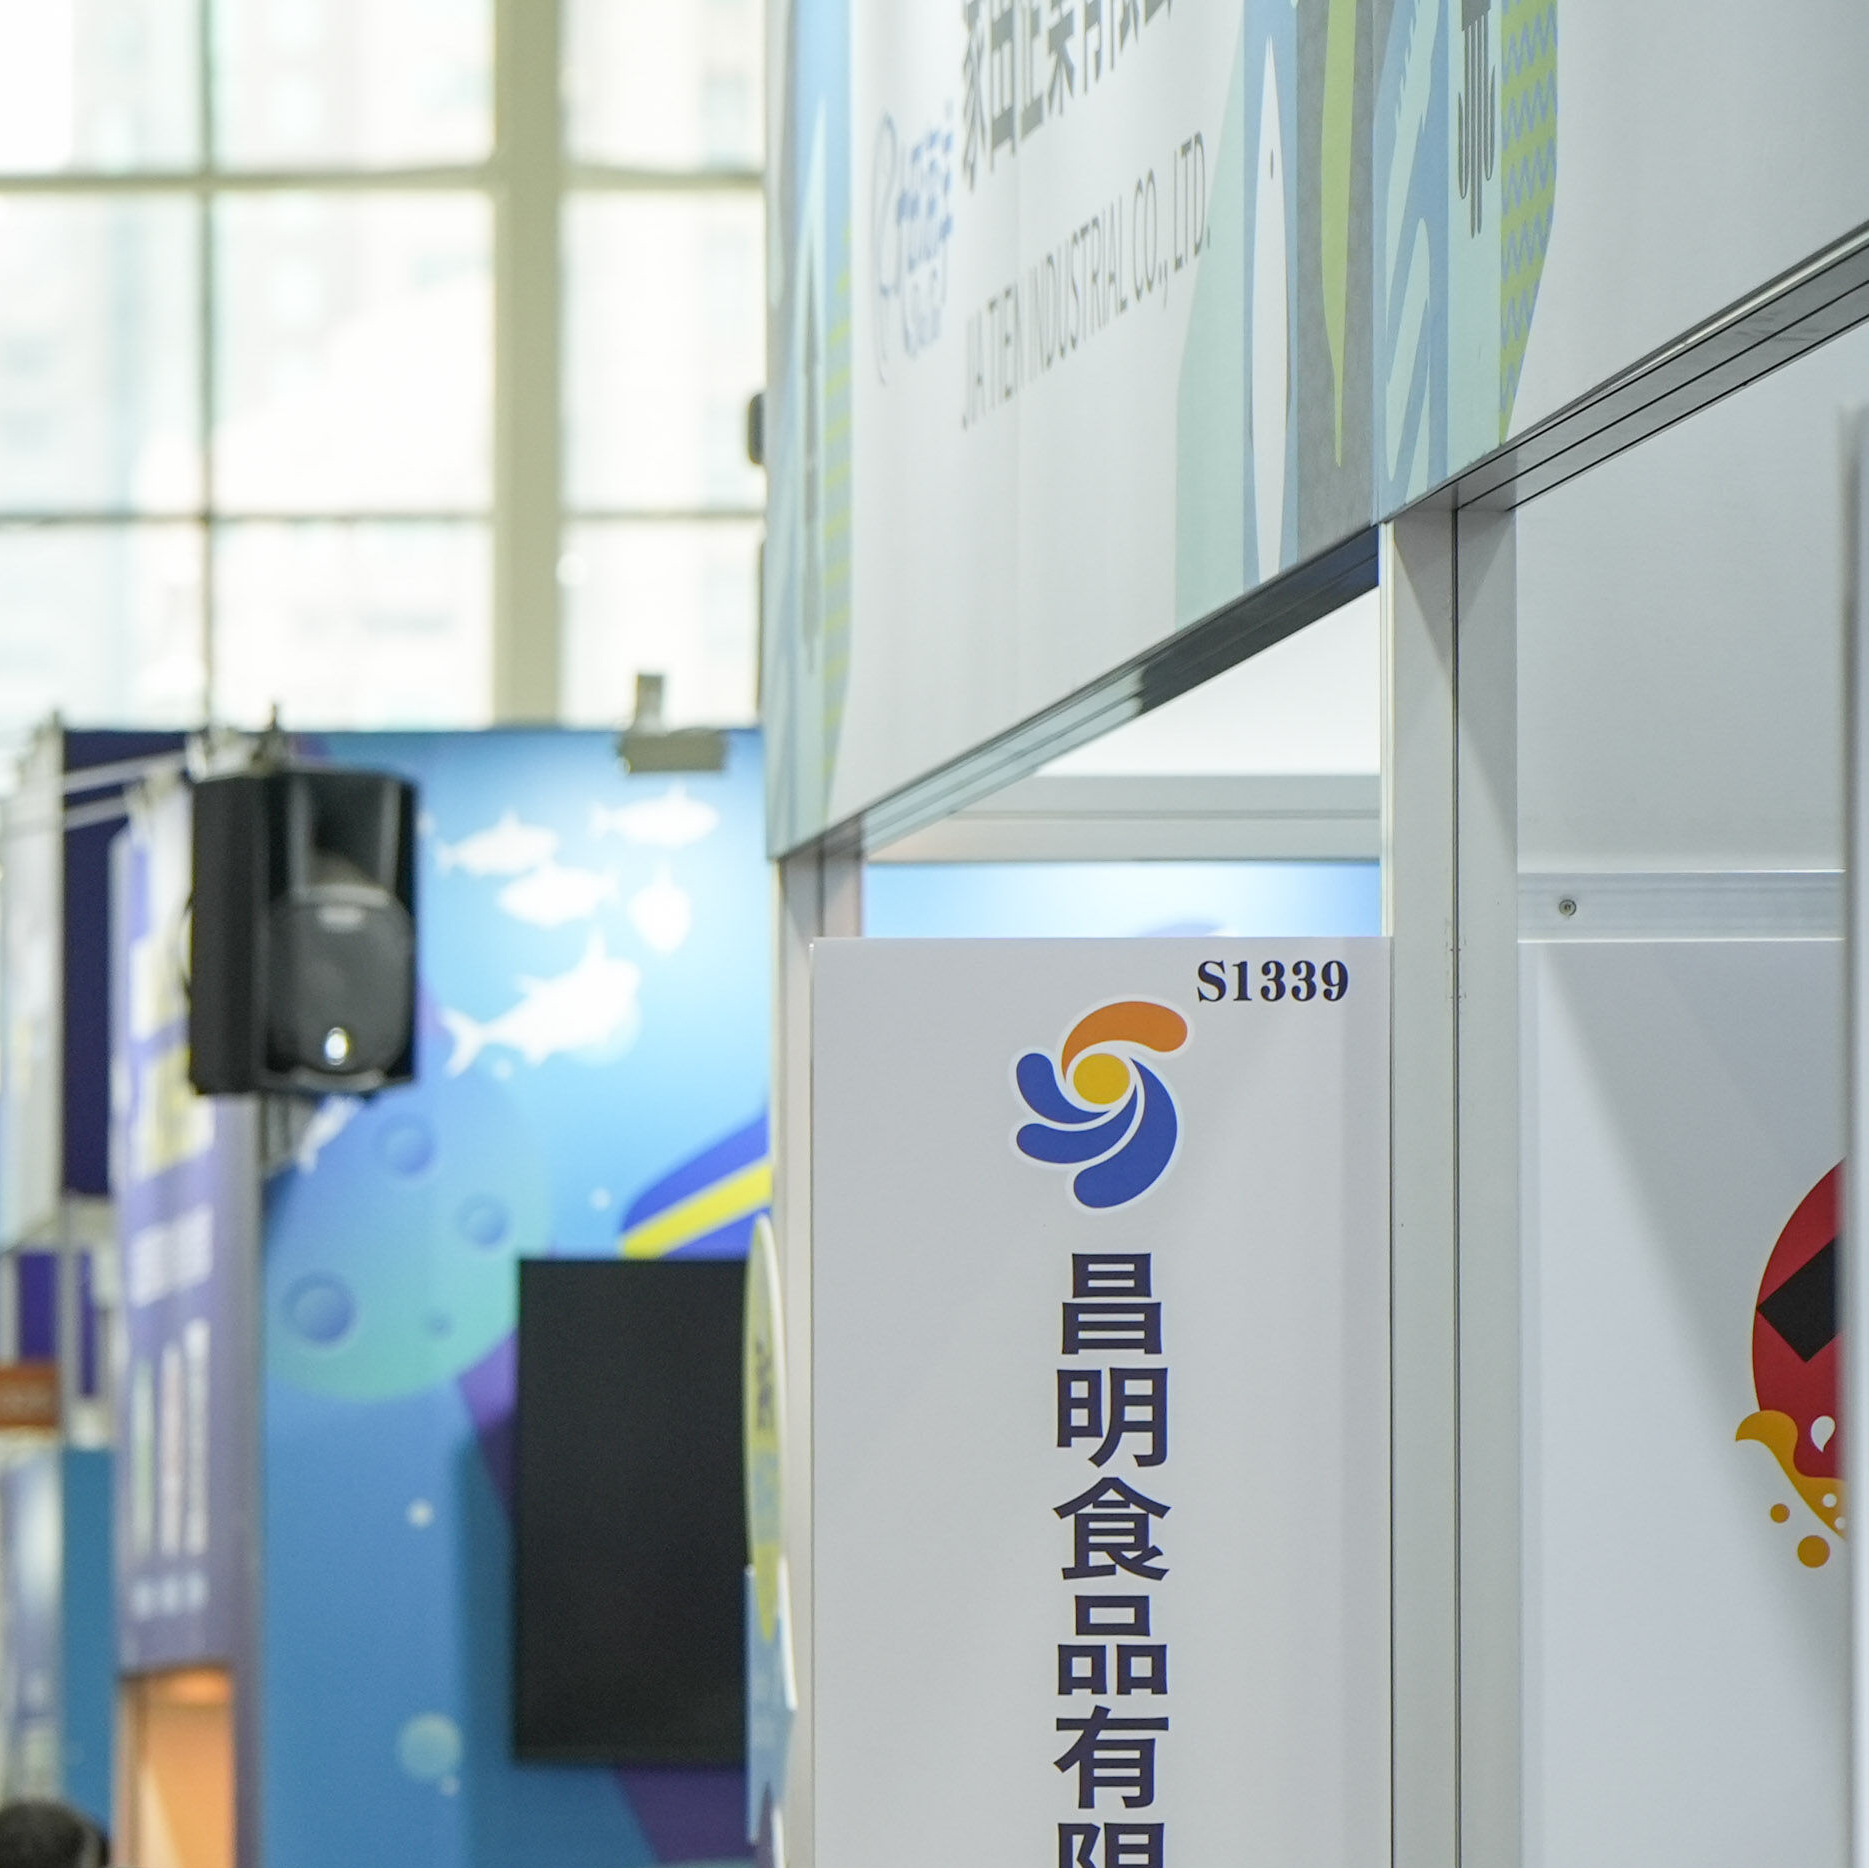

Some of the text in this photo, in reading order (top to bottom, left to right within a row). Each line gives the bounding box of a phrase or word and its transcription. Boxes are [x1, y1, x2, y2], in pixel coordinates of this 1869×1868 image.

[1028, 195, 1128, 385] INDUSTRIAL
[1174, 130, 1211, 272] LTD.
[1195, 959, 1351, 1004] S1339
